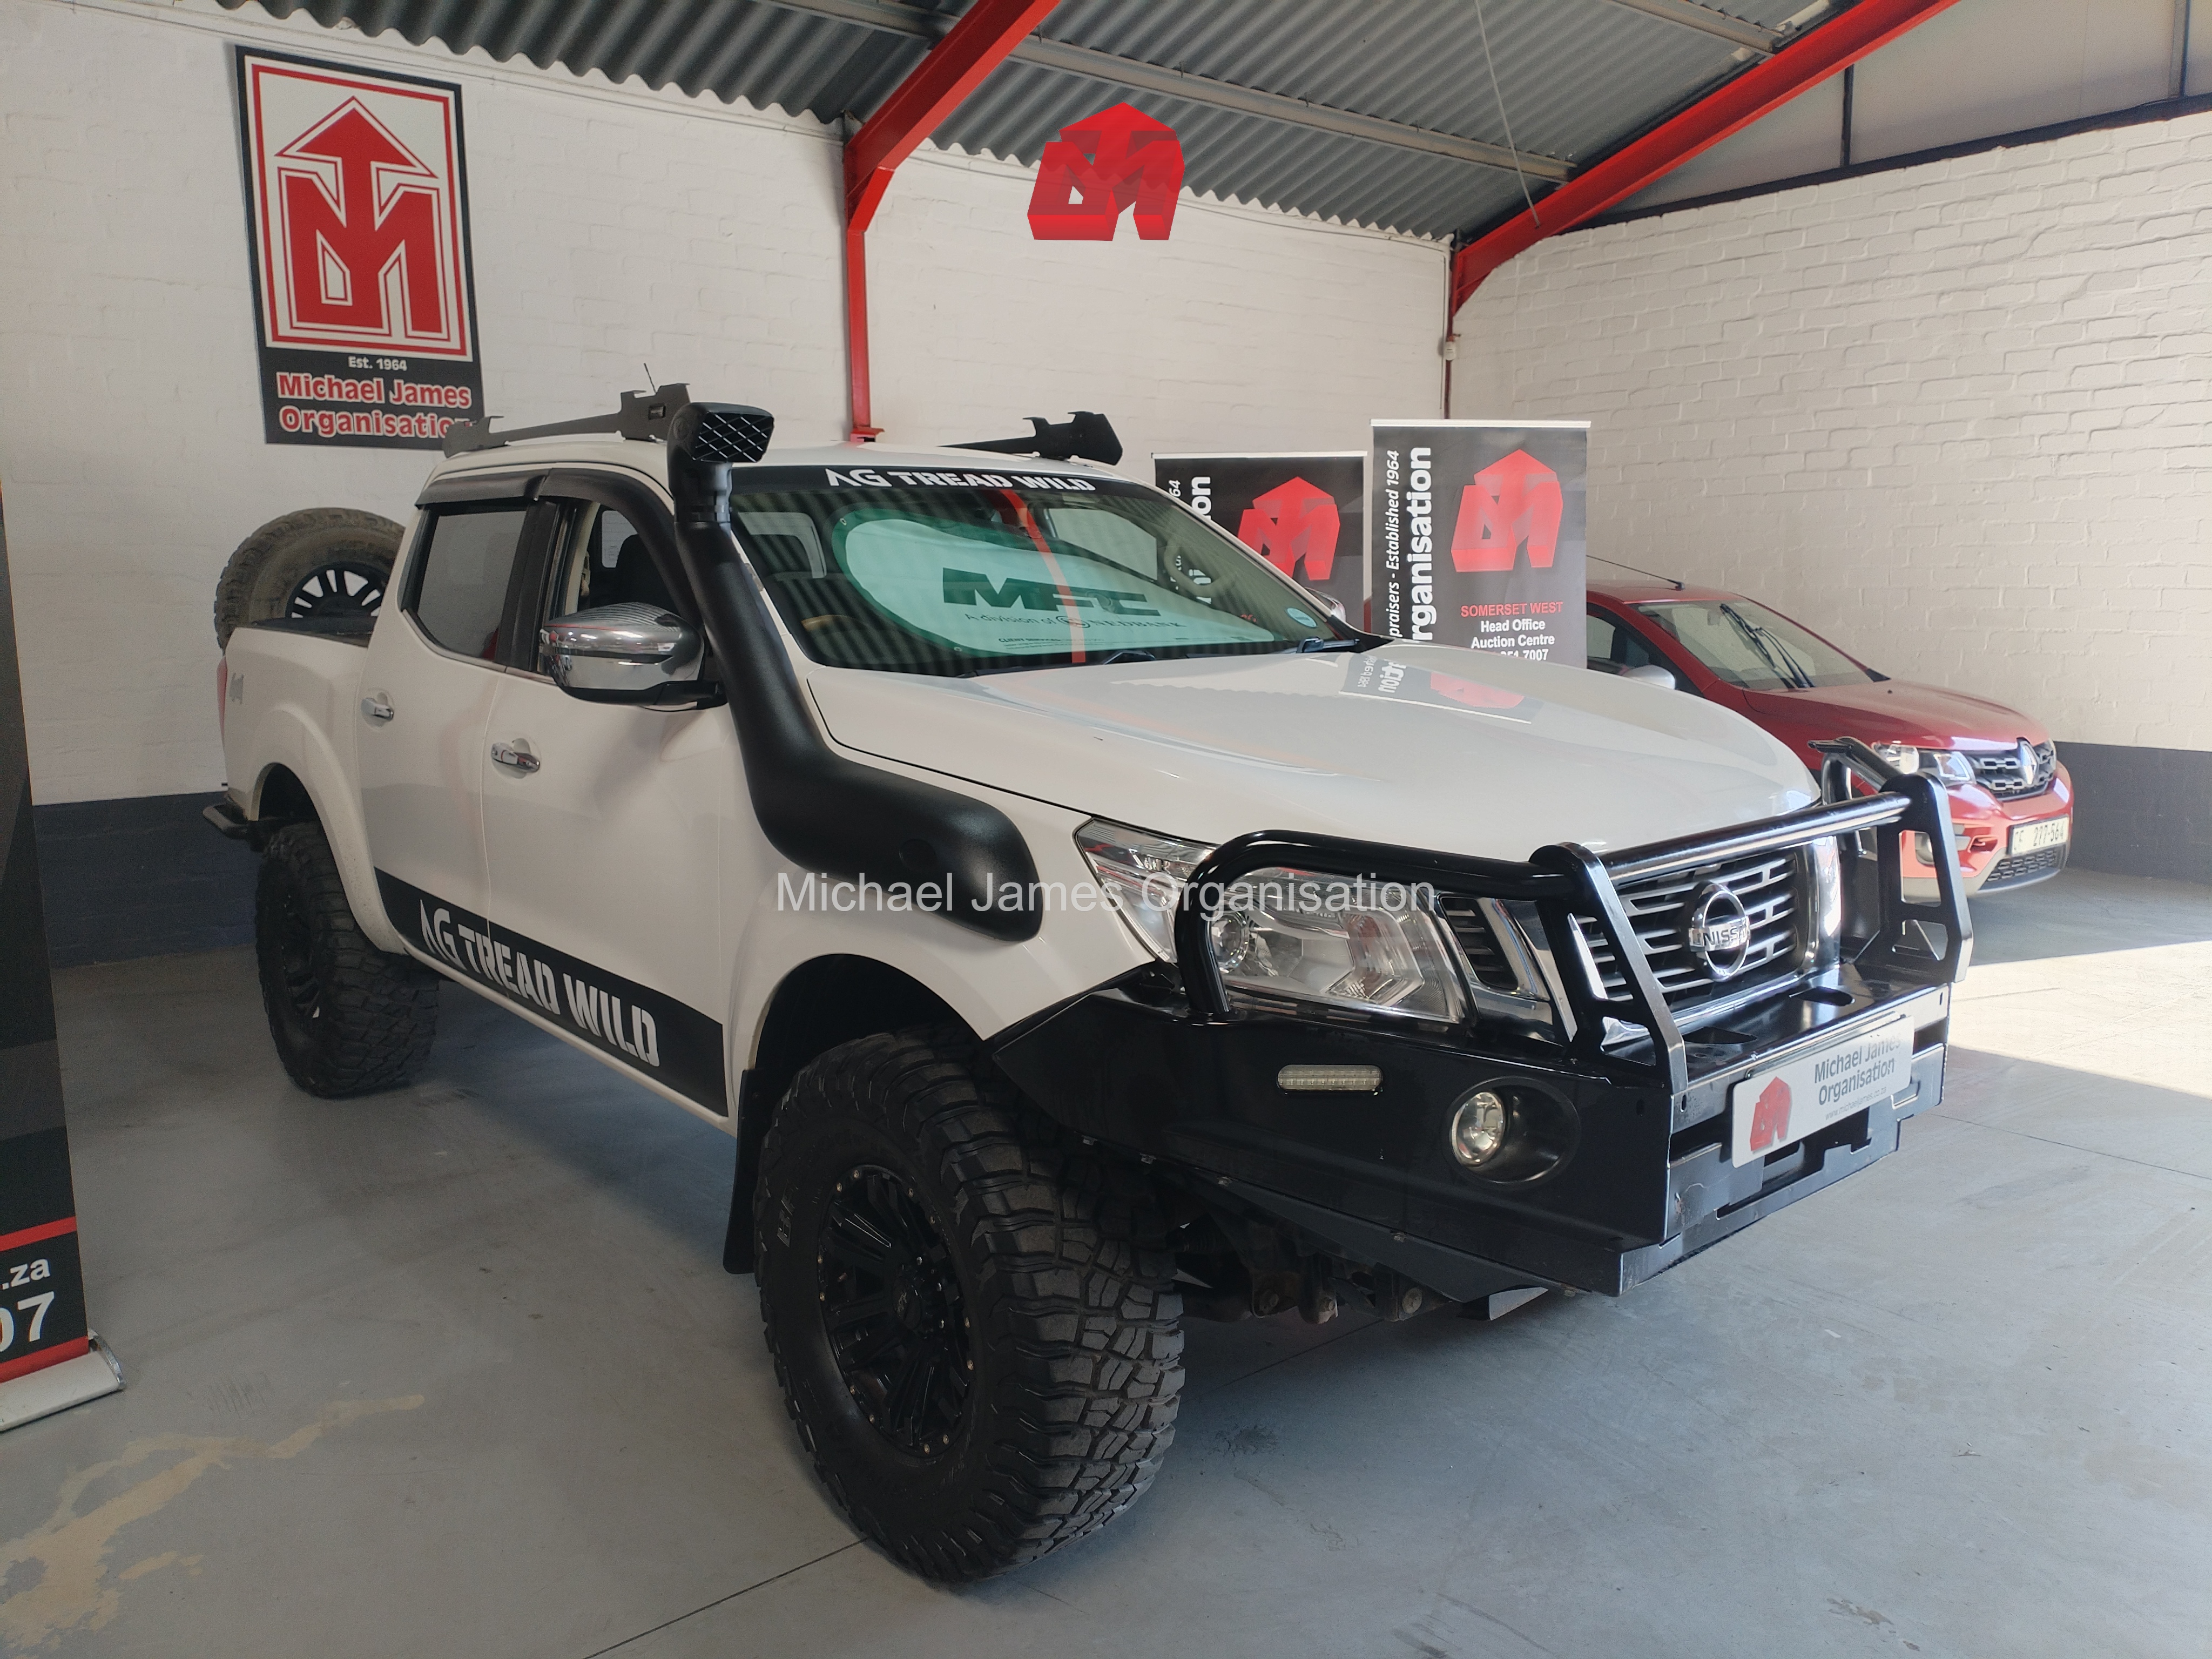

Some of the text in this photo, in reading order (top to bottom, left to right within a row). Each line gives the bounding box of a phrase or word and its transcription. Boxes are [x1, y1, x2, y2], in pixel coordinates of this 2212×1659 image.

[348, 356, 407, 371] Est. 1964
[276, 372, 471, 407] Michael James
[279, 404, 469, 439] Organisatio
[888, 471, 1015, 488] TREAD
[1011, 476, 1096, 491] WILD
[1386, 449, 1400, 485] 1964
[1386, 489, 1400, 570] Established
[1407, 447, 1437, 642] rganisation
[965, 613, 977, 621] A
[980, 615, 1040, 624] division
[1041, 617, 1057, 625] of
[1387, 582, 1404, 638] praisers
[1460, 601, 1563, 618] SOMERSET WEST
[1481, 618, 1546, 633] Head Office
[1471, 634, 1555, 649] Auction Centre
[457, 923, 561, 1015] TREAD
[563, 973, 660, 1067] WILD
[1813, 1033, 1901, 1084] Michael James
[1818, 1057, 1895, 1106] Organisation
